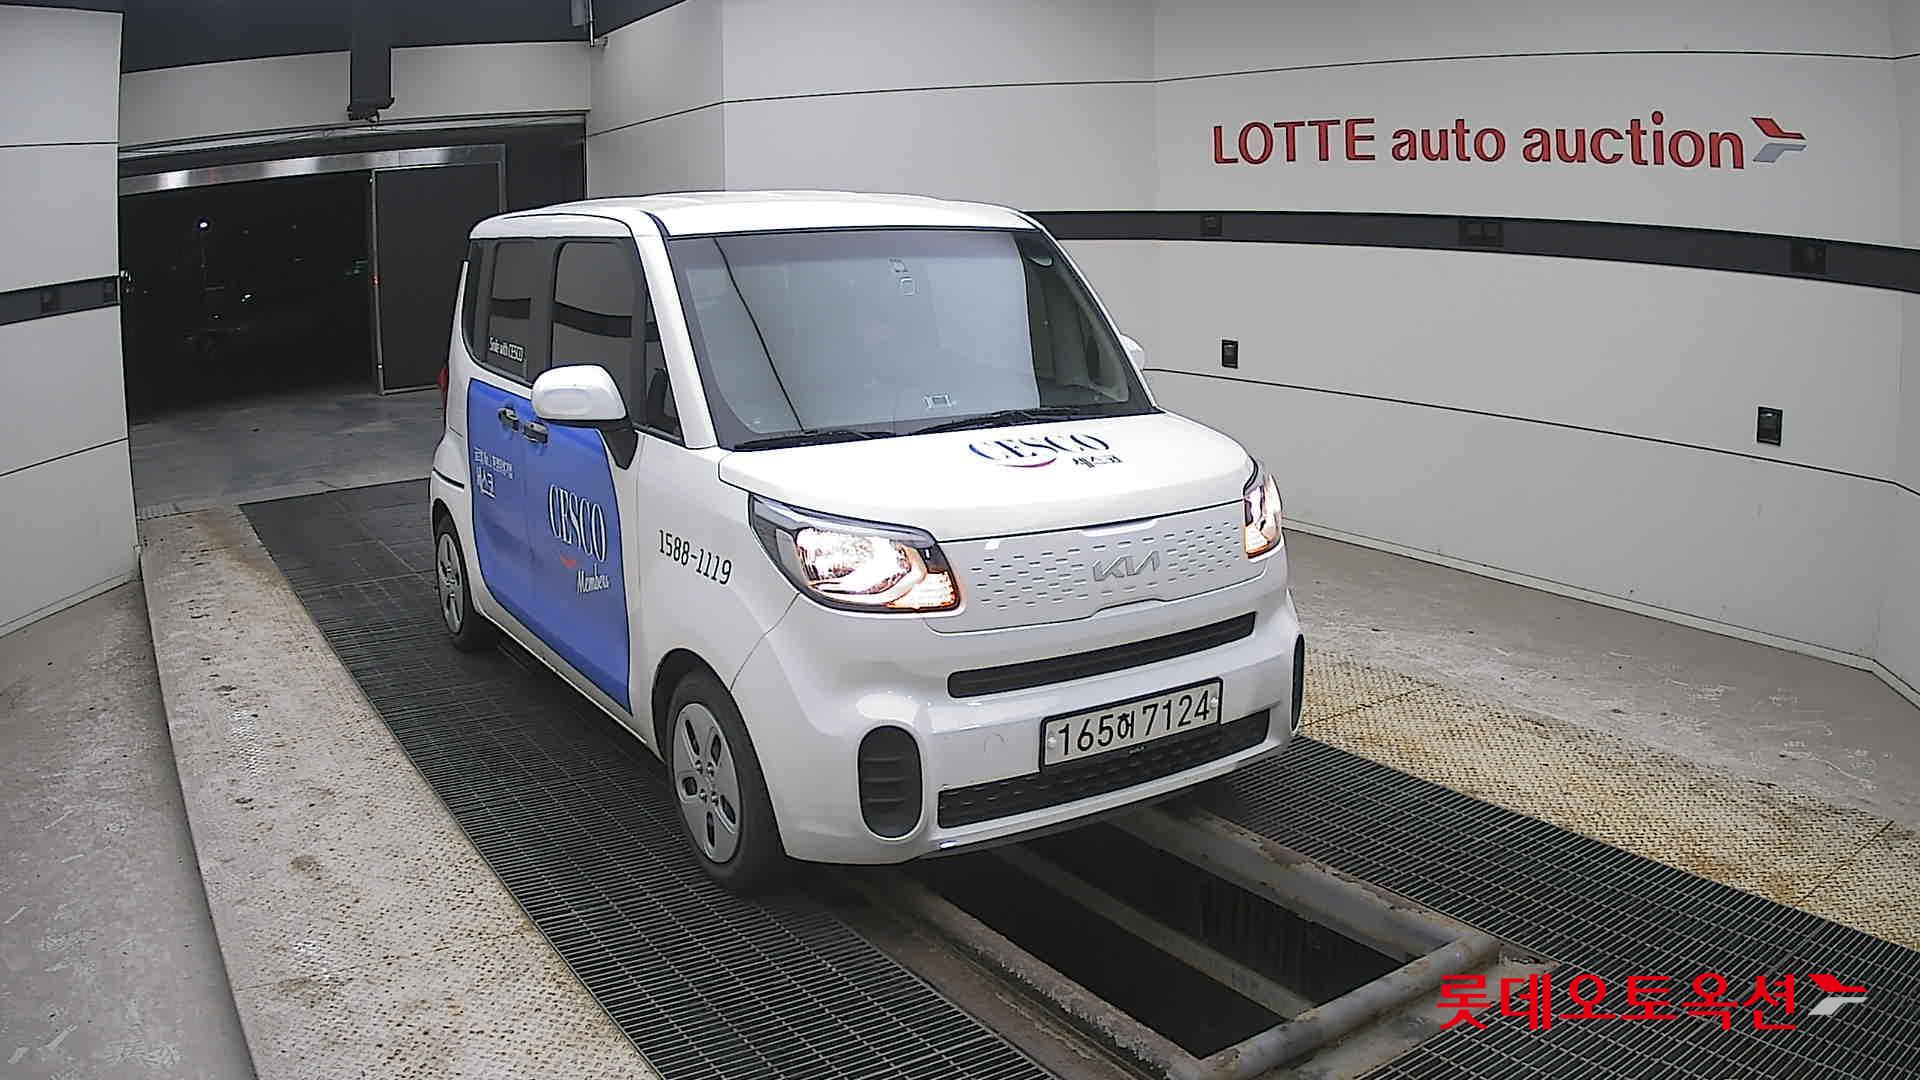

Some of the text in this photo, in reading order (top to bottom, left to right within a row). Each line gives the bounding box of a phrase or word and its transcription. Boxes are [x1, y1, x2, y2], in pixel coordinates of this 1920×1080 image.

[1213, 111, 1744, 169] LOTTE auto auction
[968, 434, 1110, 459] CESCO
[548, 484, 607, 562] CESCO
[658, 529, 732, 586] 1588-1119
[1092, 550, 1160, 582] KIA
[1058, 690, 1210, 756] 165허 7124
